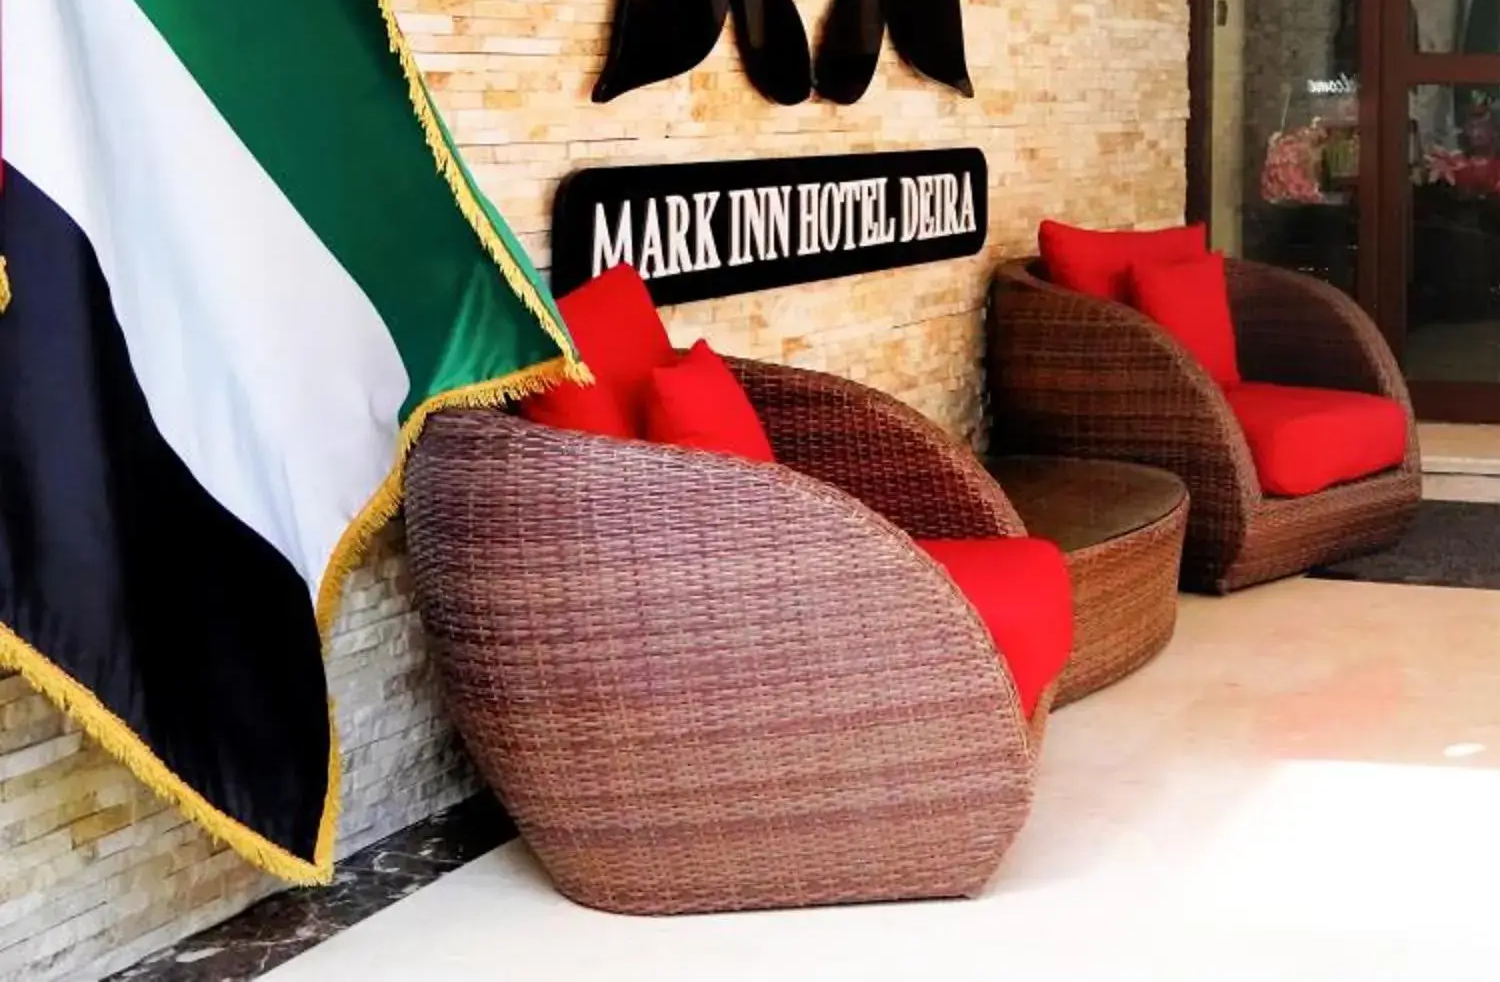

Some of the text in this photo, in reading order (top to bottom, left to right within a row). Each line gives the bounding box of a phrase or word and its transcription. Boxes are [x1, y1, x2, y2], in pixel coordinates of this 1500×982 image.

[591, 170, 978, 281] MARK INN HOTEL DEIRA
